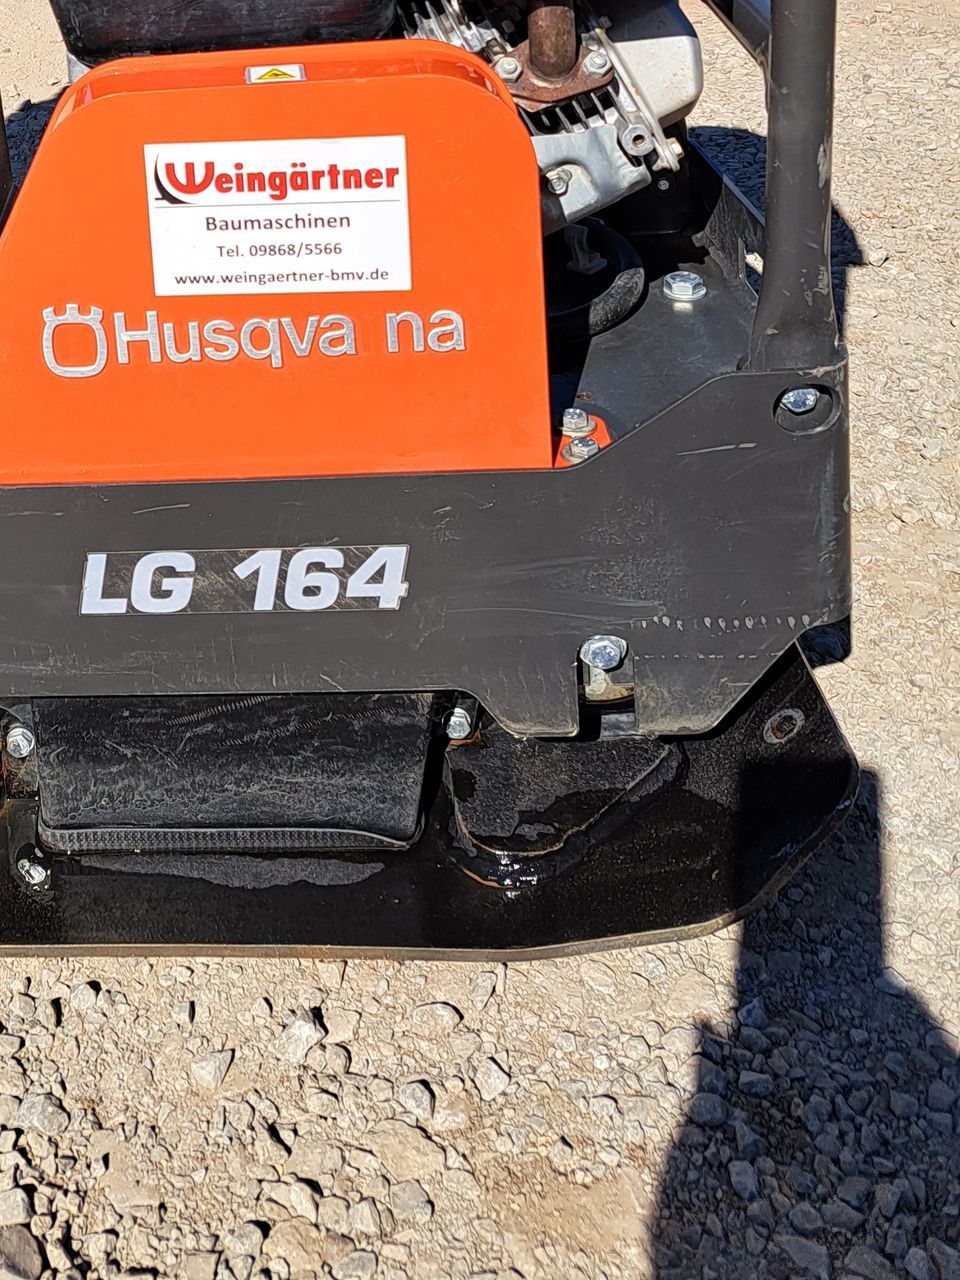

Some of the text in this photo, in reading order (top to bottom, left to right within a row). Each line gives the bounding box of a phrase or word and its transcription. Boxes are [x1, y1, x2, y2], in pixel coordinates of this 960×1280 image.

[165, 161, 399, 201] Weingärtner
[205, 213, 351, 231] Baumaschinen
[216, 242, 342, 258] Tel. 09868/5566
[175, 268, 389, 286] www.weingaertner-bmv.de
[80, 546, 408, 615] LG 164
